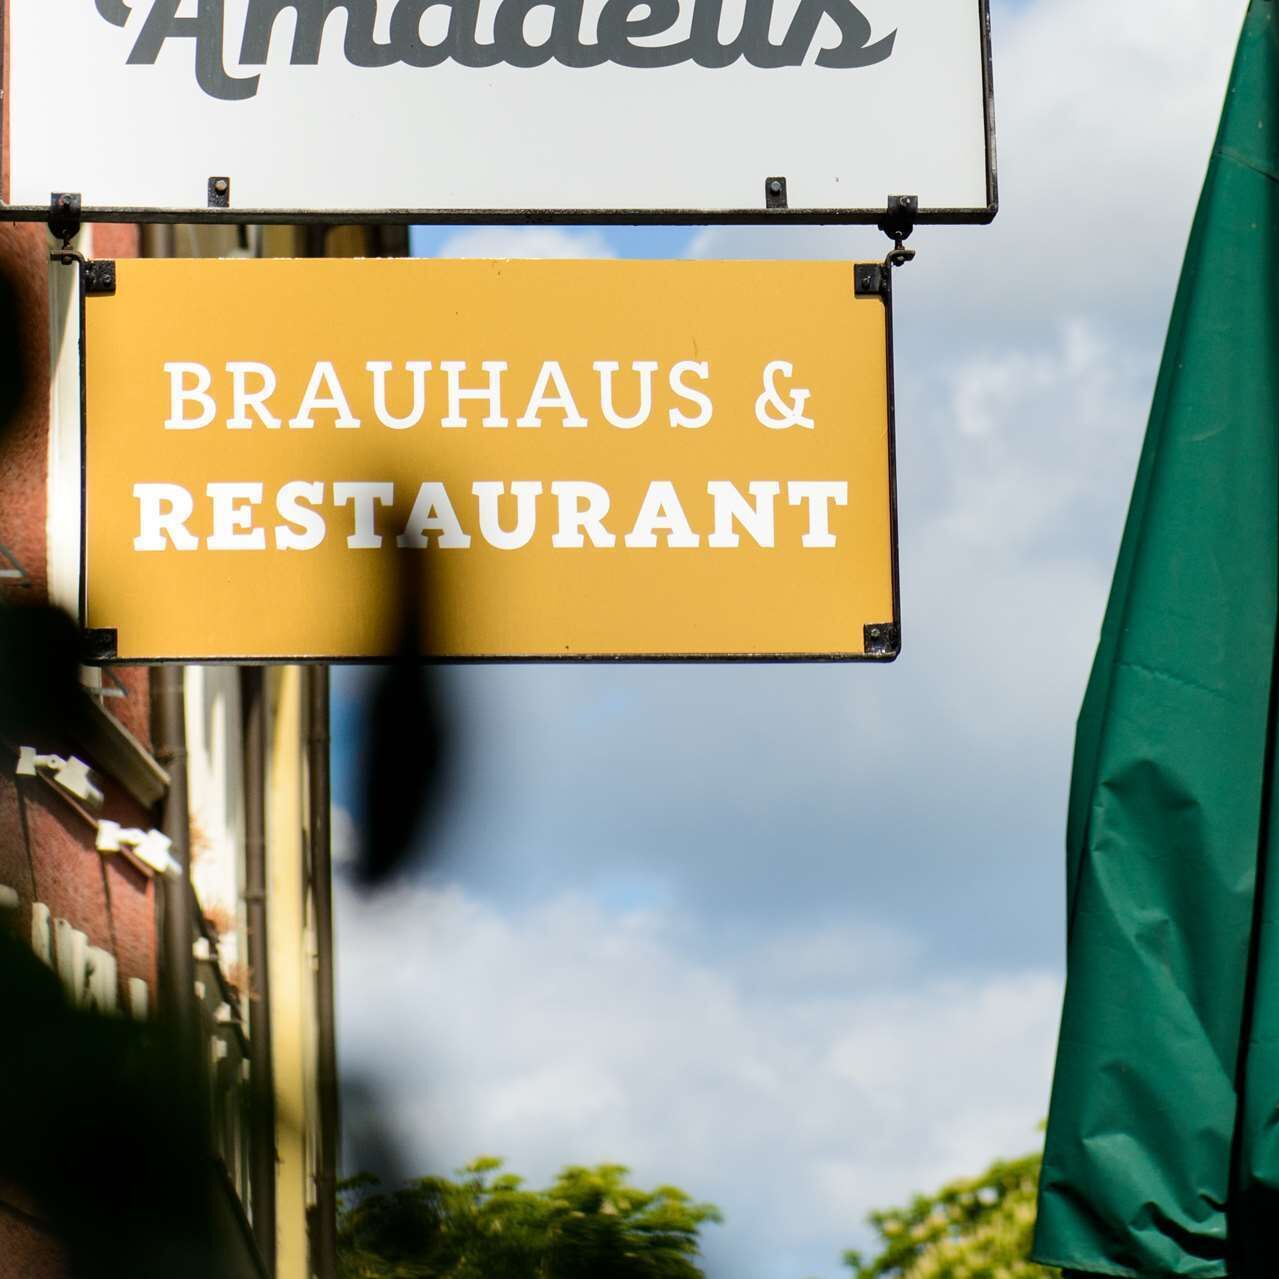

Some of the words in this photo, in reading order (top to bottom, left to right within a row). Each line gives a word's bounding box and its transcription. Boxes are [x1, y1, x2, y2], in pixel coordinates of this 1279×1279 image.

[164, 360, 712, 429] BRAUHAUS
[755, 360, 815, 429] &
[133, 480, 848, 551] RESTAURANT
